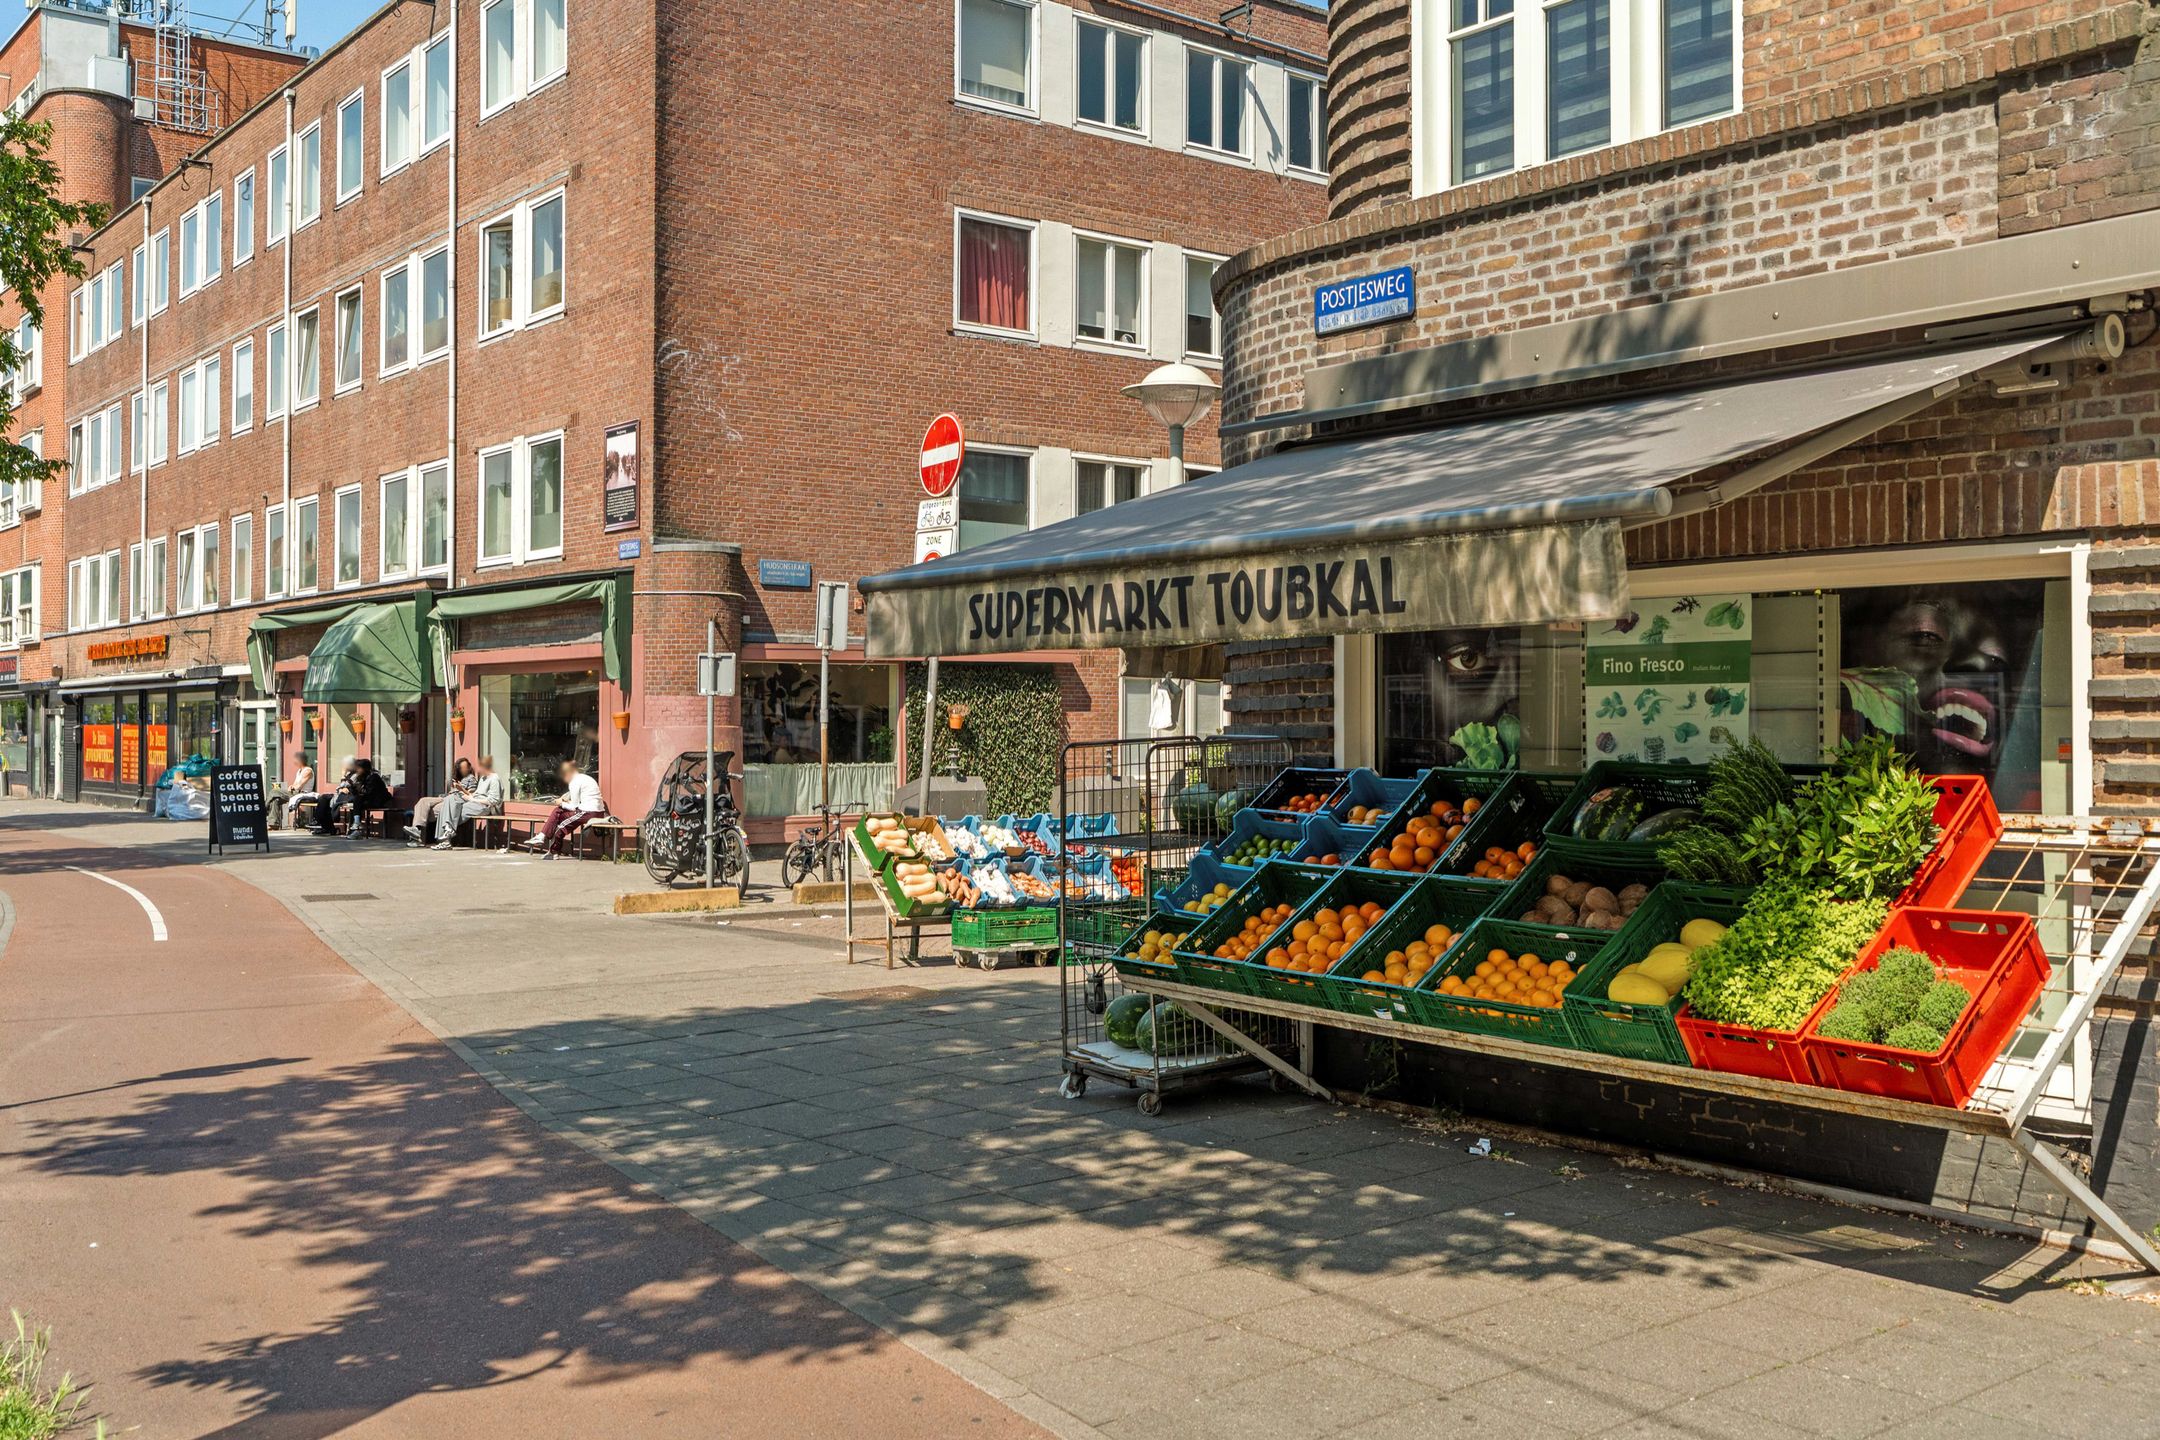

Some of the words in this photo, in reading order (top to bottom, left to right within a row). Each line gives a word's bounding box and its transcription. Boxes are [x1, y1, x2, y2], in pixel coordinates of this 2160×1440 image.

[1321, 274, 1405, 311] POSTJESWEG
[926, 536, 942, 546] ZONE
[763, 561, 807, 571] HUDSONSTRAAT
[969, 575, 1194, 640] SUPERMARKT
[1207, 556, 1406, 626] TOUBKAL
[1602, 658, 1634, 673] Fino
[1640, 657, 1685, 672] Fresco
[218, 770, 257, 780] coffee
[219, 781, 258, 791] cakes
[220, 793, 259, 802] beans
[221, 803, 260, 813] wines
